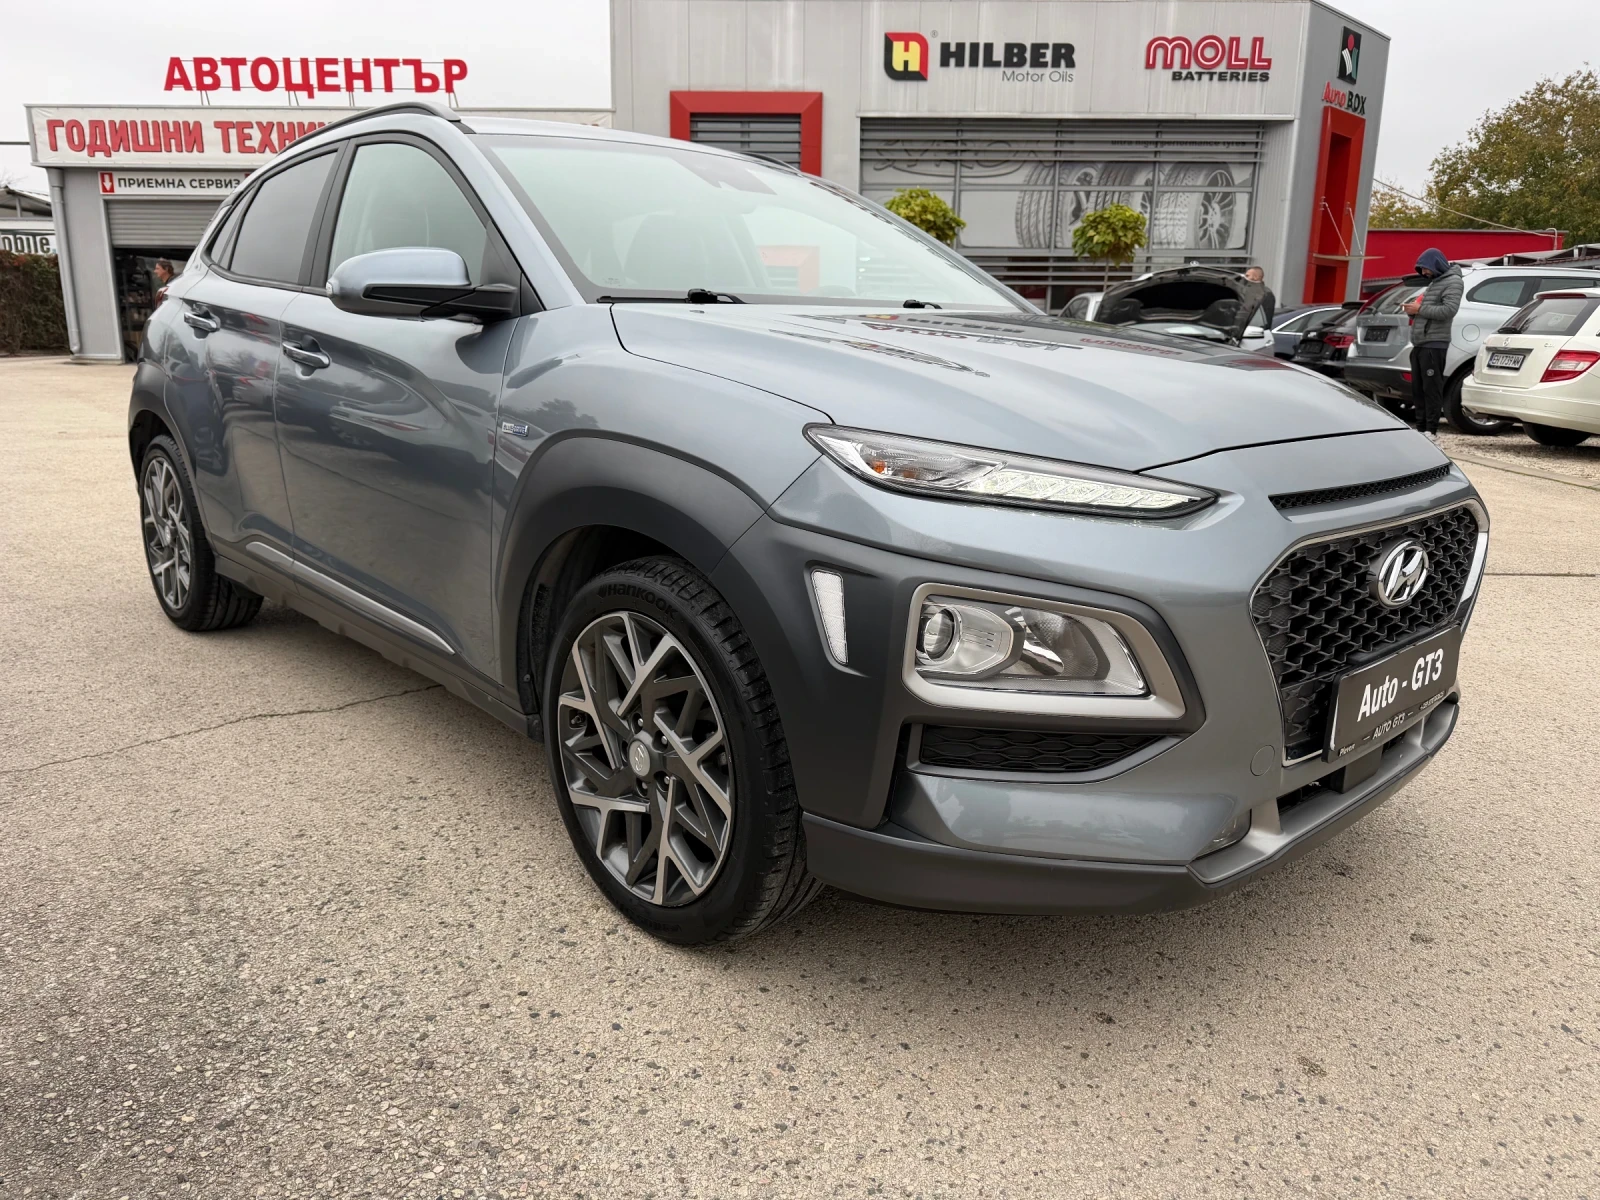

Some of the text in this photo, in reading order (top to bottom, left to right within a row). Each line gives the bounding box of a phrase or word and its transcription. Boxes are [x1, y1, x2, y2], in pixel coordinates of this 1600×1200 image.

[940, 42, 1076, 68] HILBER
[164, 57, 468, 98] АВТОЦЕНТЪР
[1002, 70, 1074, 82] Motor Oils
[1172, 71, 1270, 82] BATTERIES
[1347, 89, 1367, 115] BOX
[46, 119, 326, 157] ГОДИШНИ ТЕХН
[118, 177, 240, 189] ПРИЕМНА СЕРВИЗ
[1357, 674, 1398, 722] Auto
[1412, 648, 1444, 691] GT3
[1372, 720, 1391, 740] AUTO
